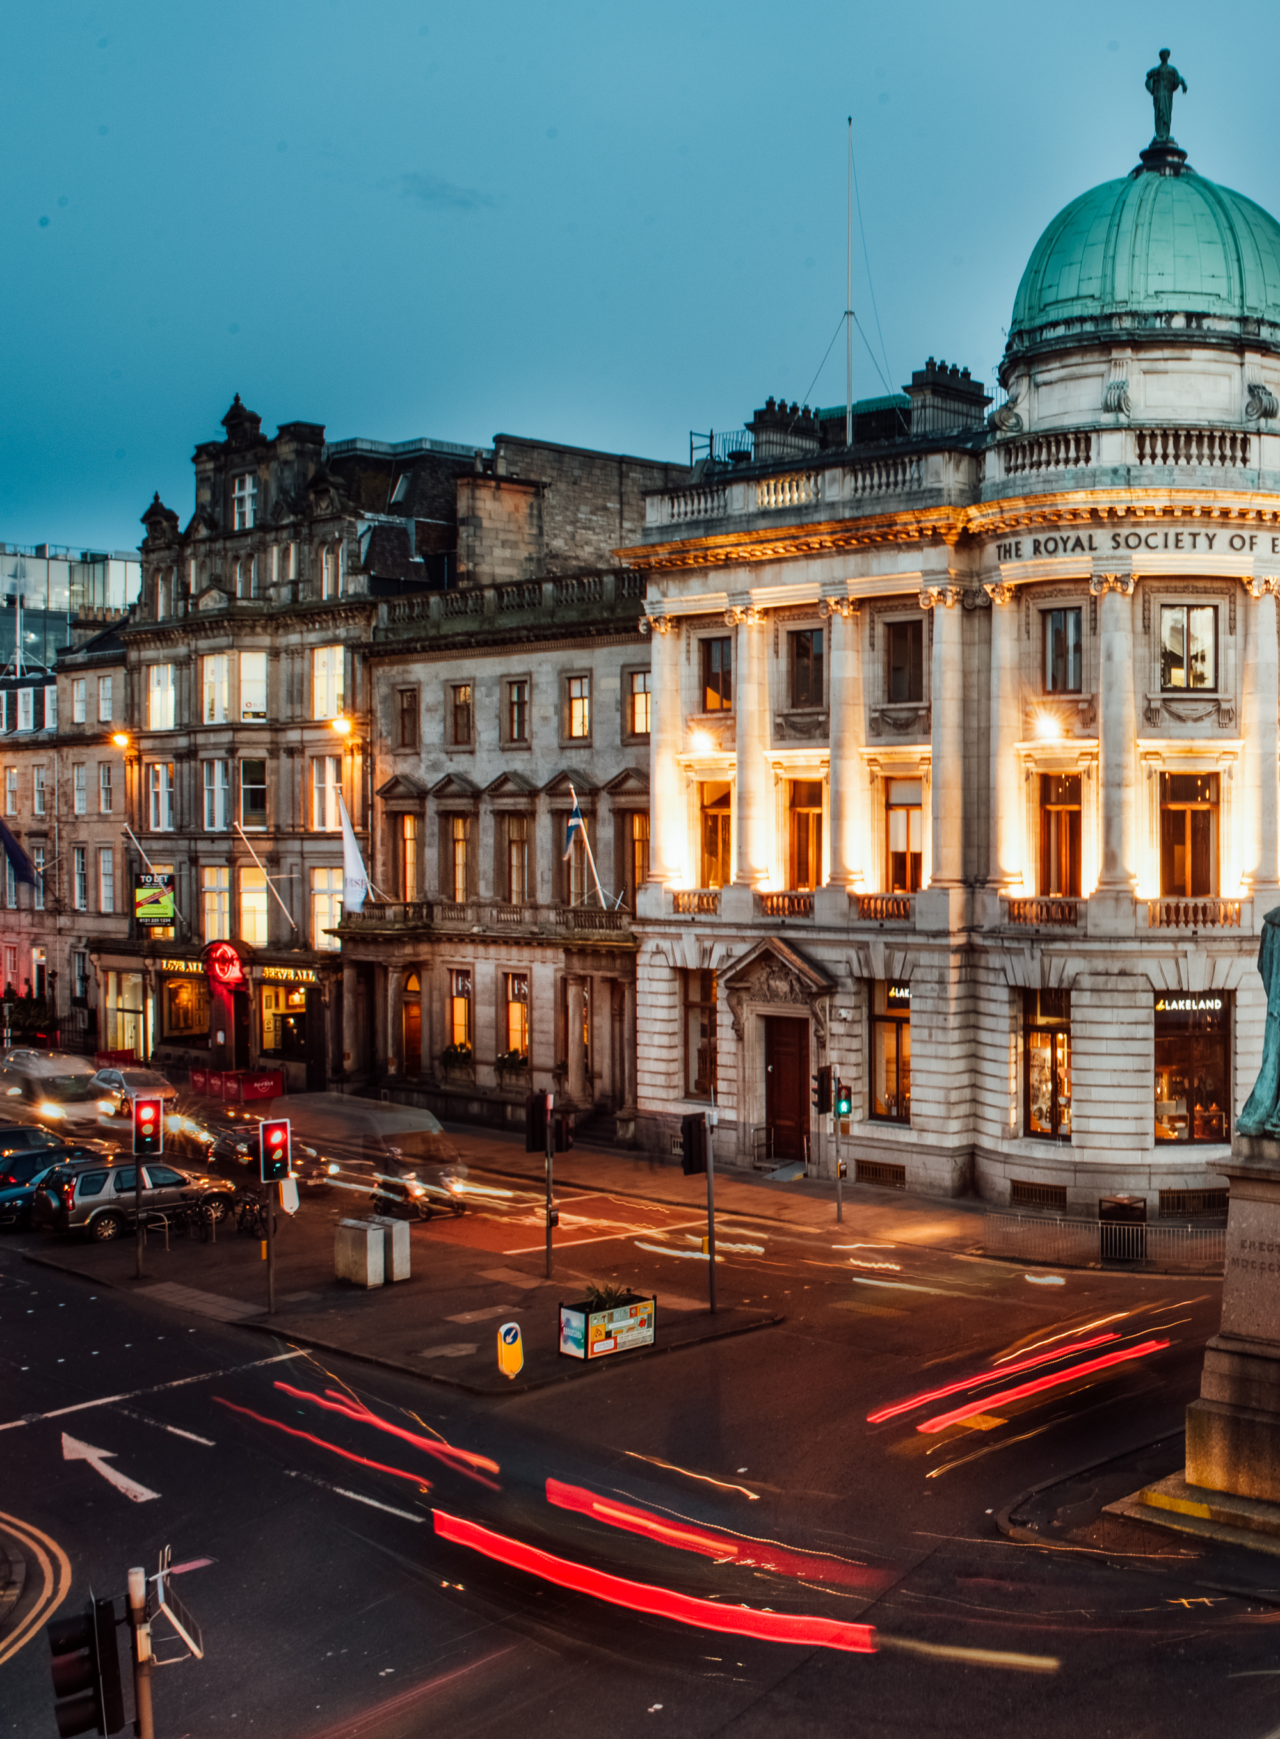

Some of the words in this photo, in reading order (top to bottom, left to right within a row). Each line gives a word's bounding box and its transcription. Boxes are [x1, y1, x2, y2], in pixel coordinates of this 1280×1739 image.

[995, 540, 1023, 560] THE
[1032, 533, 1099, 555] ROYAL
[1111, 531, 1218, 550] SOCIETY
[1229, 533, 1259, 551] OF
[140, 875, 153, 883] TO
[153, 875, 169, 883] LET
[161, 959, 185, 972] LOVE
[185, 961, 205, 974] ALL
[262, 967, 295, 980] SERVE
[294, 969, 316, 983] ALL
[1165, 999, 1223, 1010] LAKELAND
